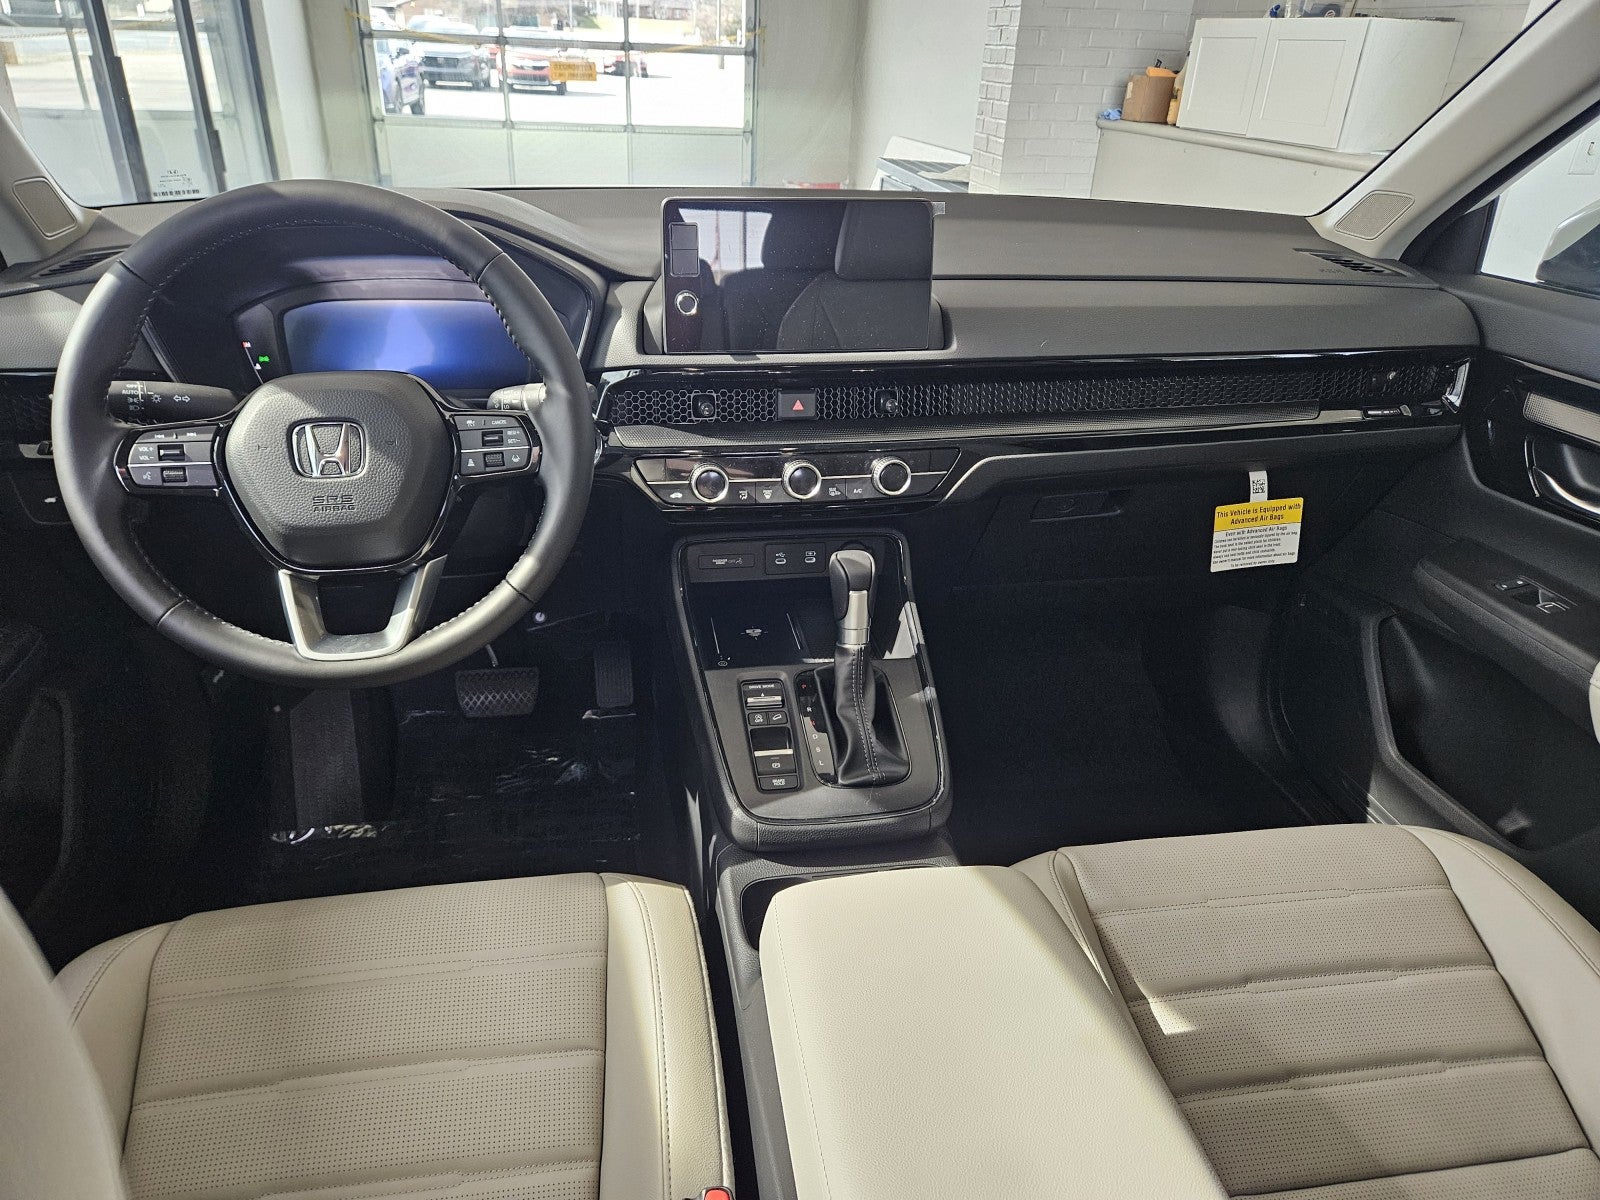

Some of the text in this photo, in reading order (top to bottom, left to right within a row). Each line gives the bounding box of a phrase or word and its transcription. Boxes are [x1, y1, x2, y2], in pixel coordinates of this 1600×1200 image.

[313, 495, 354, 504] SRS
[313, 505, 355, 513] AIRBAG
[1230, 508, 1251, 517] Vehicle
[1260, 504, 1287, 513] Equipped
[1230, 516, 1258, 525] Advanced
